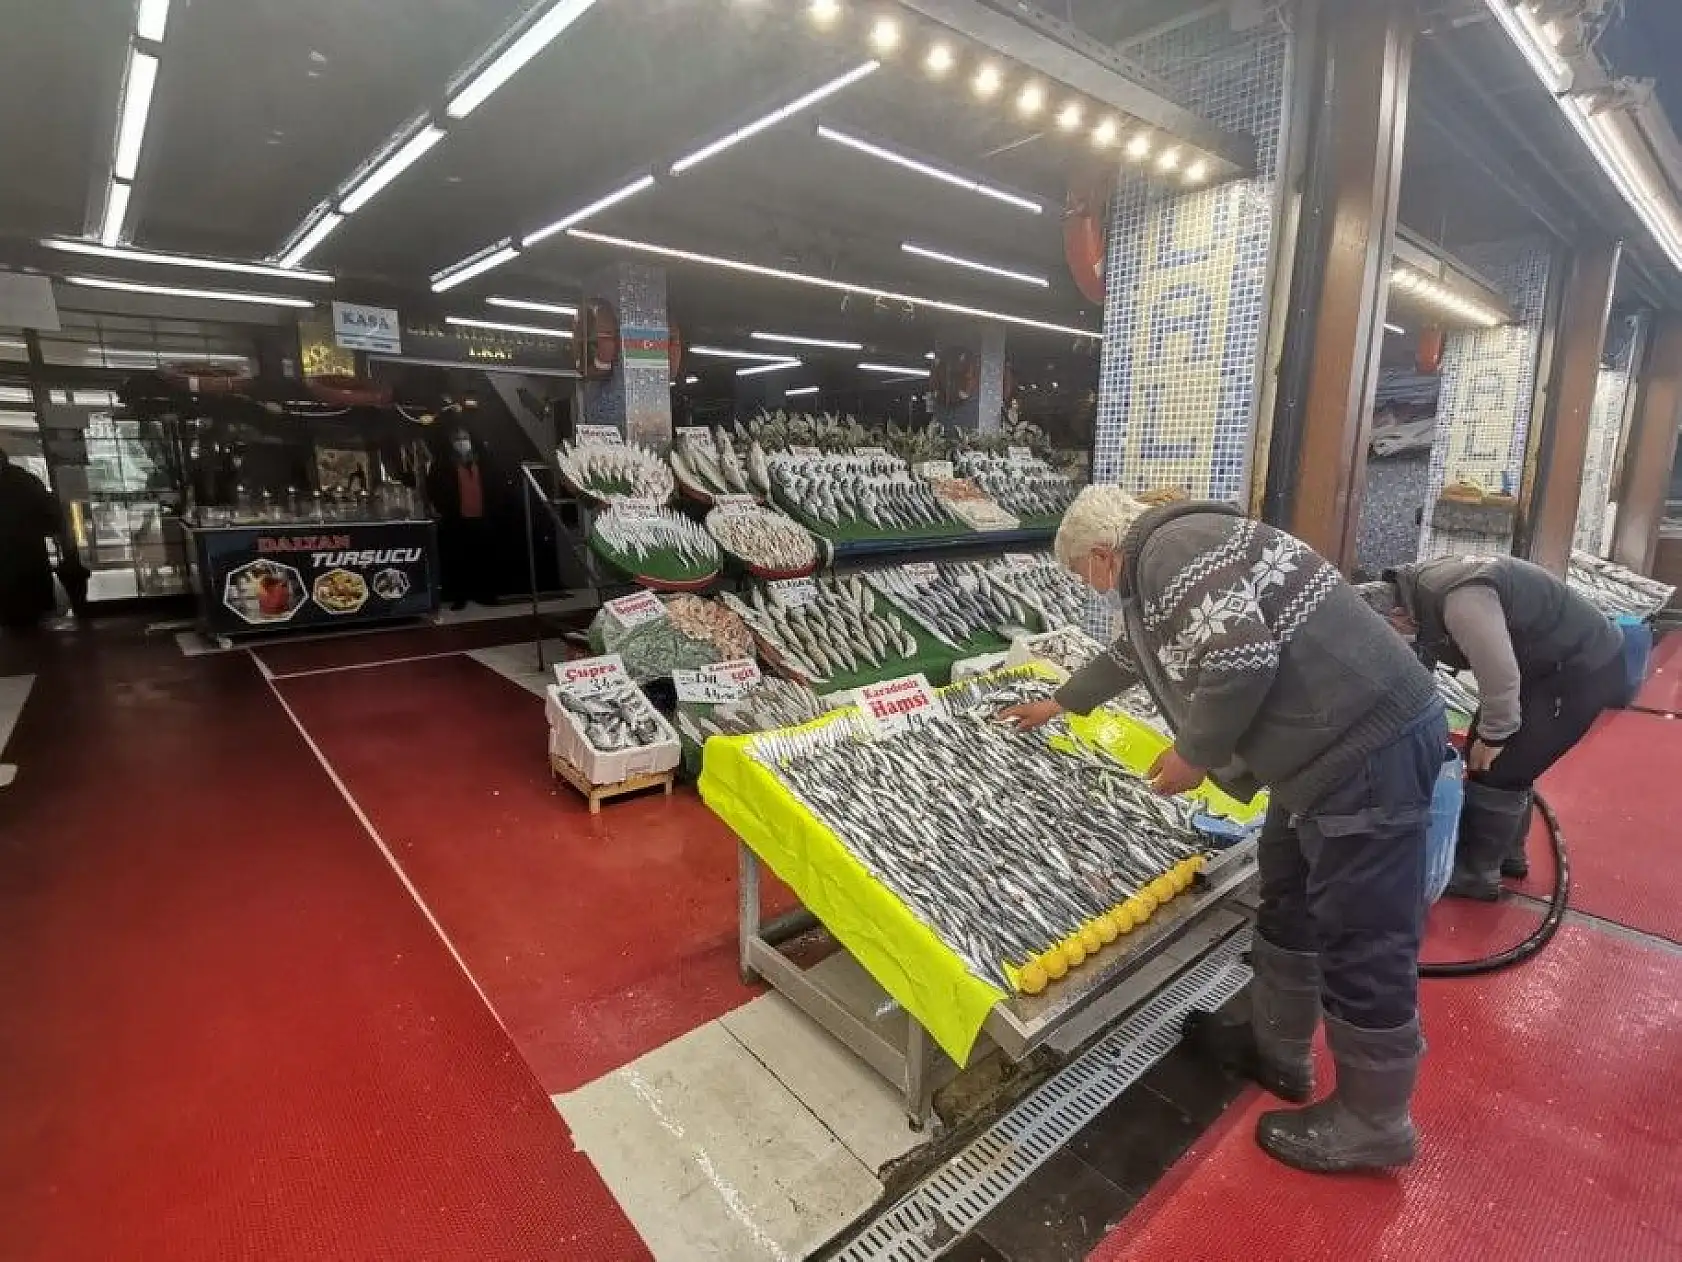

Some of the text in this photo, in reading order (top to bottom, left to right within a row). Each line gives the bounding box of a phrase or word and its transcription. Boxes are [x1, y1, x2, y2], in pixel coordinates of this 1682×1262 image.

[342, 310, 390, 330] KASA
[311, 547, 422, 569] TURŞUCU
[862, 679, 918, 700] Karadeniz
[868, 689, 929, 718] Hamsi
